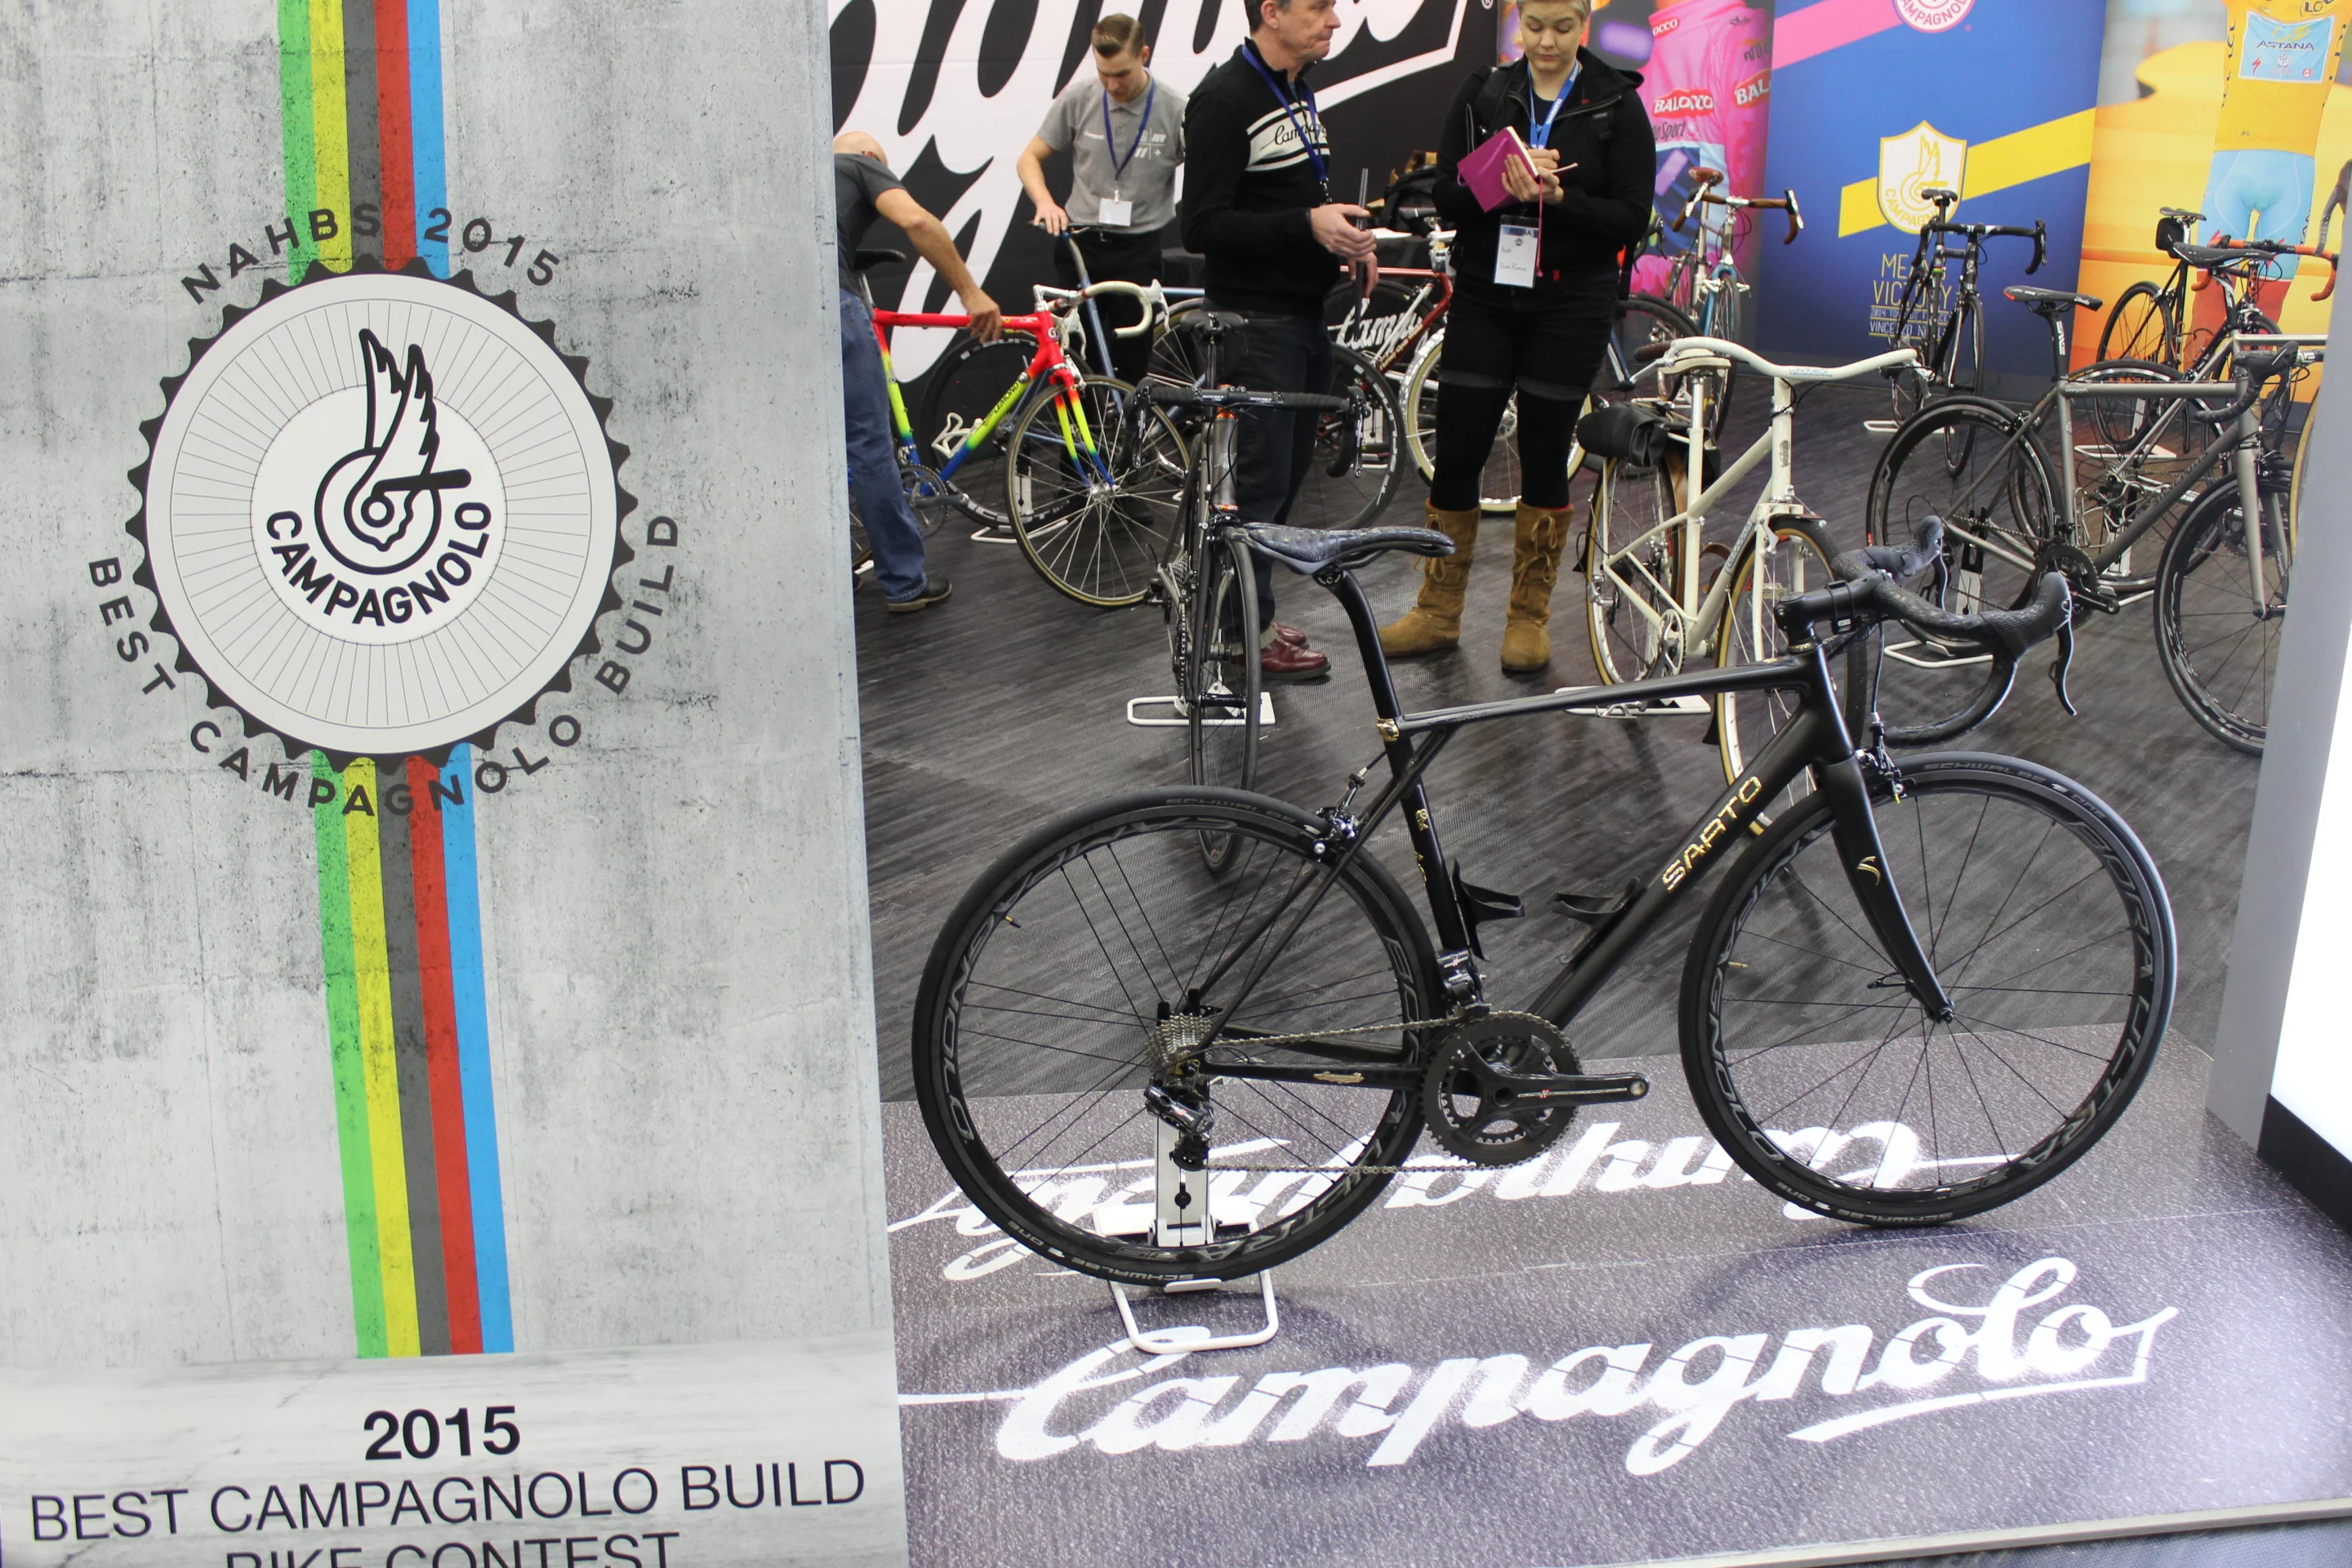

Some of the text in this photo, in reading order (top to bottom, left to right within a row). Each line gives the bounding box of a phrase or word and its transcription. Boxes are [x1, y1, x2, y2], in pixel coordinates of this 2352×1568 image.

[2256, 40, 2314, 51] ASTANA
[1654, 95, 1714, 114] BALOCCO
[1735, 77, 1771, 105] BAL
[1661, 121, 1686, 140] Sport
[181, 204, 562, 305] NAHBS 2015
[1869, 321, 1913, 336] VINCEZO
[266, 501, 492, 626] CAMPAGNOLO
[88, 514, 679, 817] BEST CAMPAGNOLO BUILD
[992, 1254, 2179, 1477] Campagnolo
[363, 1405, 520, 1460] 2015
[31, 1459, 864, 1540] BEST CAMPAGNOLO BUILD
